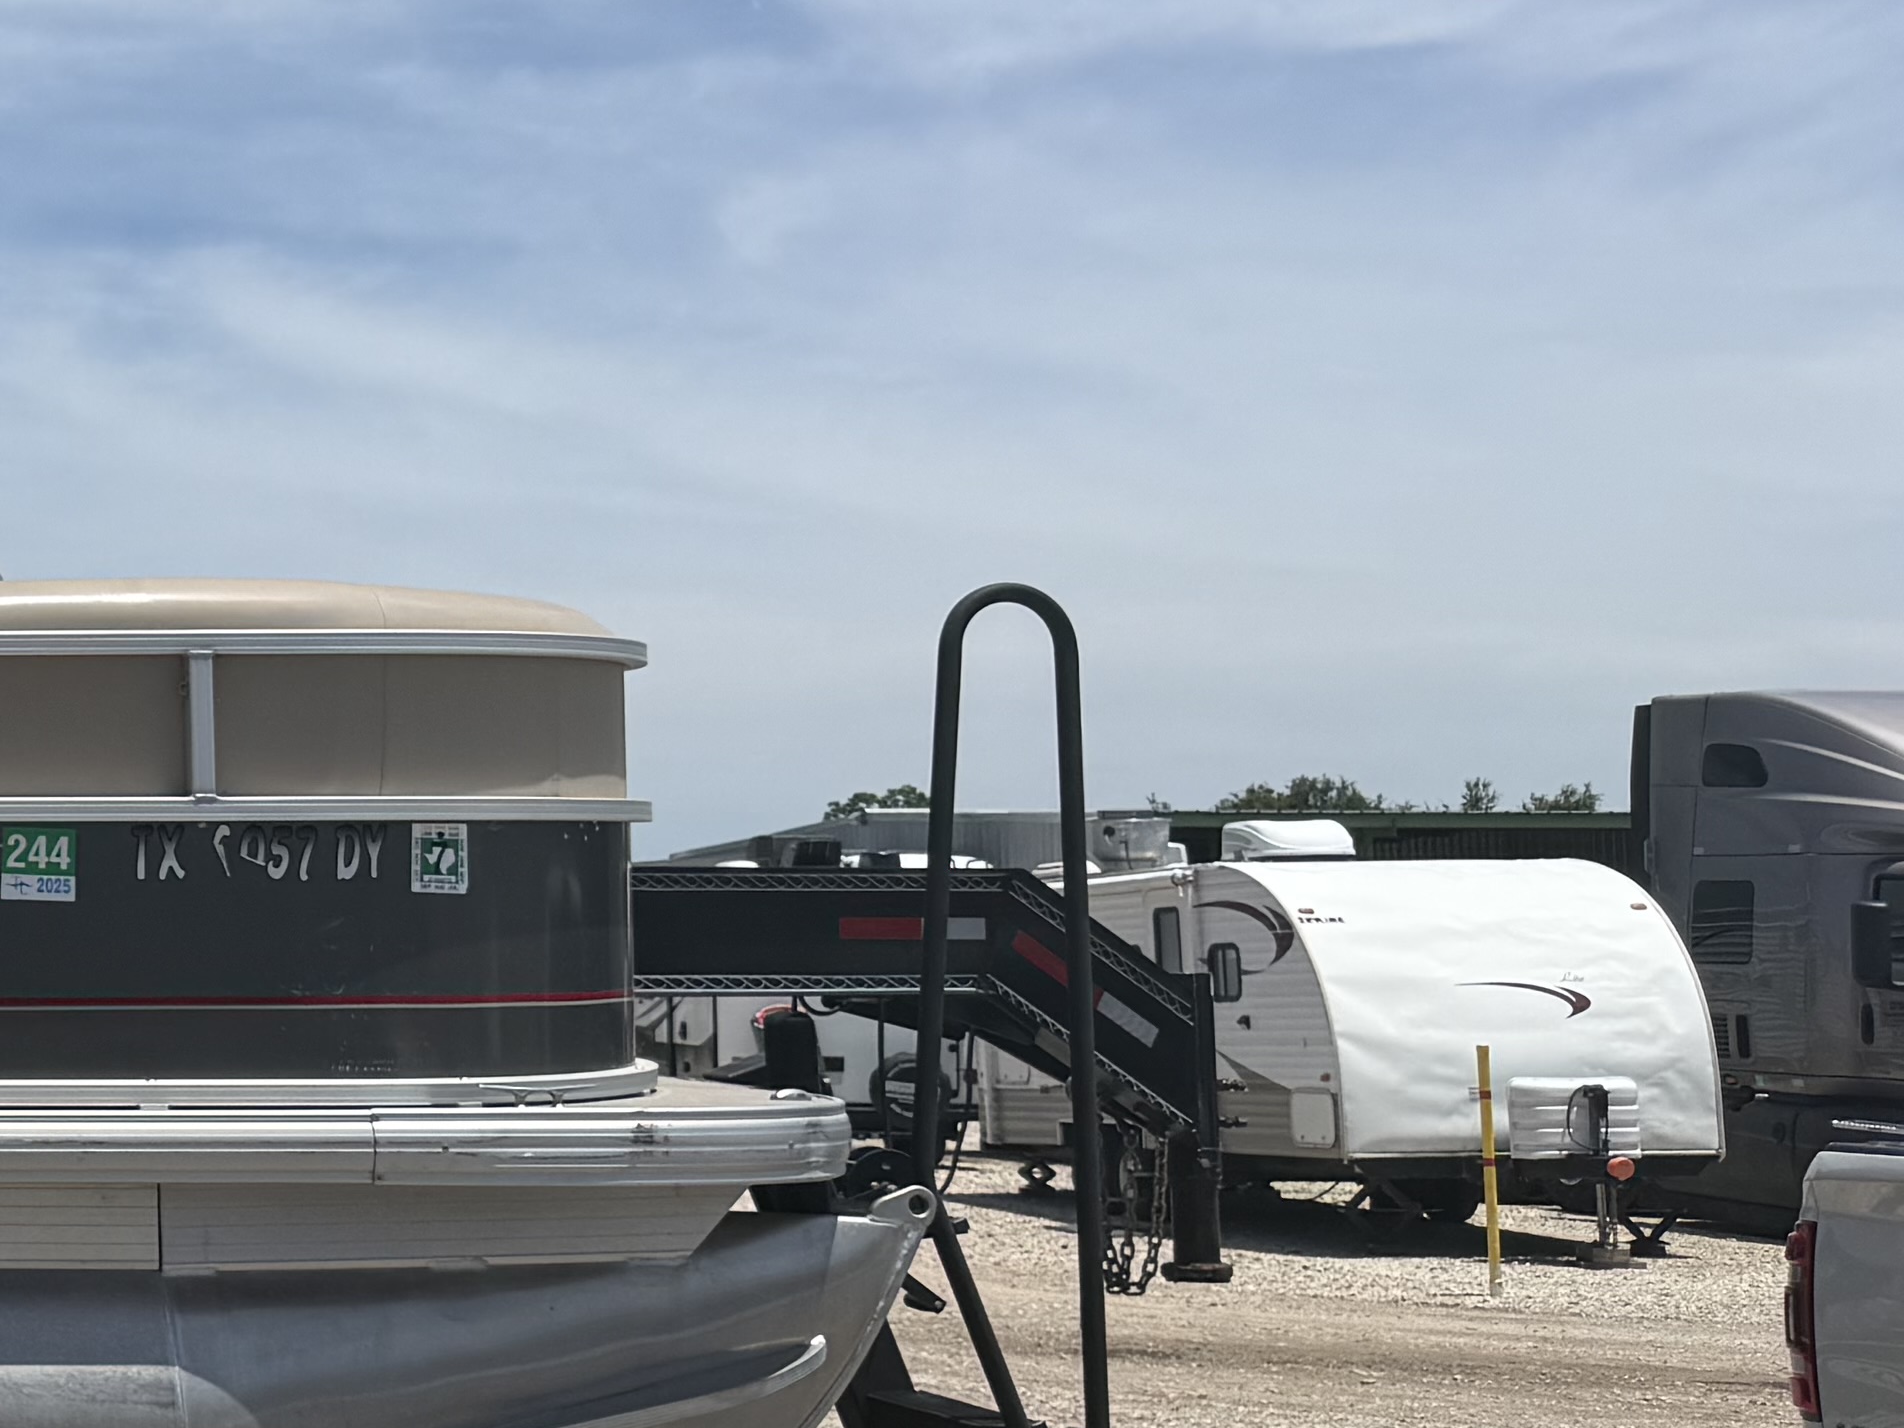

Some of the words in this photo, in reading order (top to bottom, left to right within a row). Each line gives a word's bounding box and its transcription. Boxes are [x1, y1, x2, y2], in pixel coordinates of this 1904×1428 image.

[6, 833, 71, 870] 244
[131, 825, 185, 880] TX
[336, 825, 387, 880] DY
[36, 877, 72, 894] 2025
